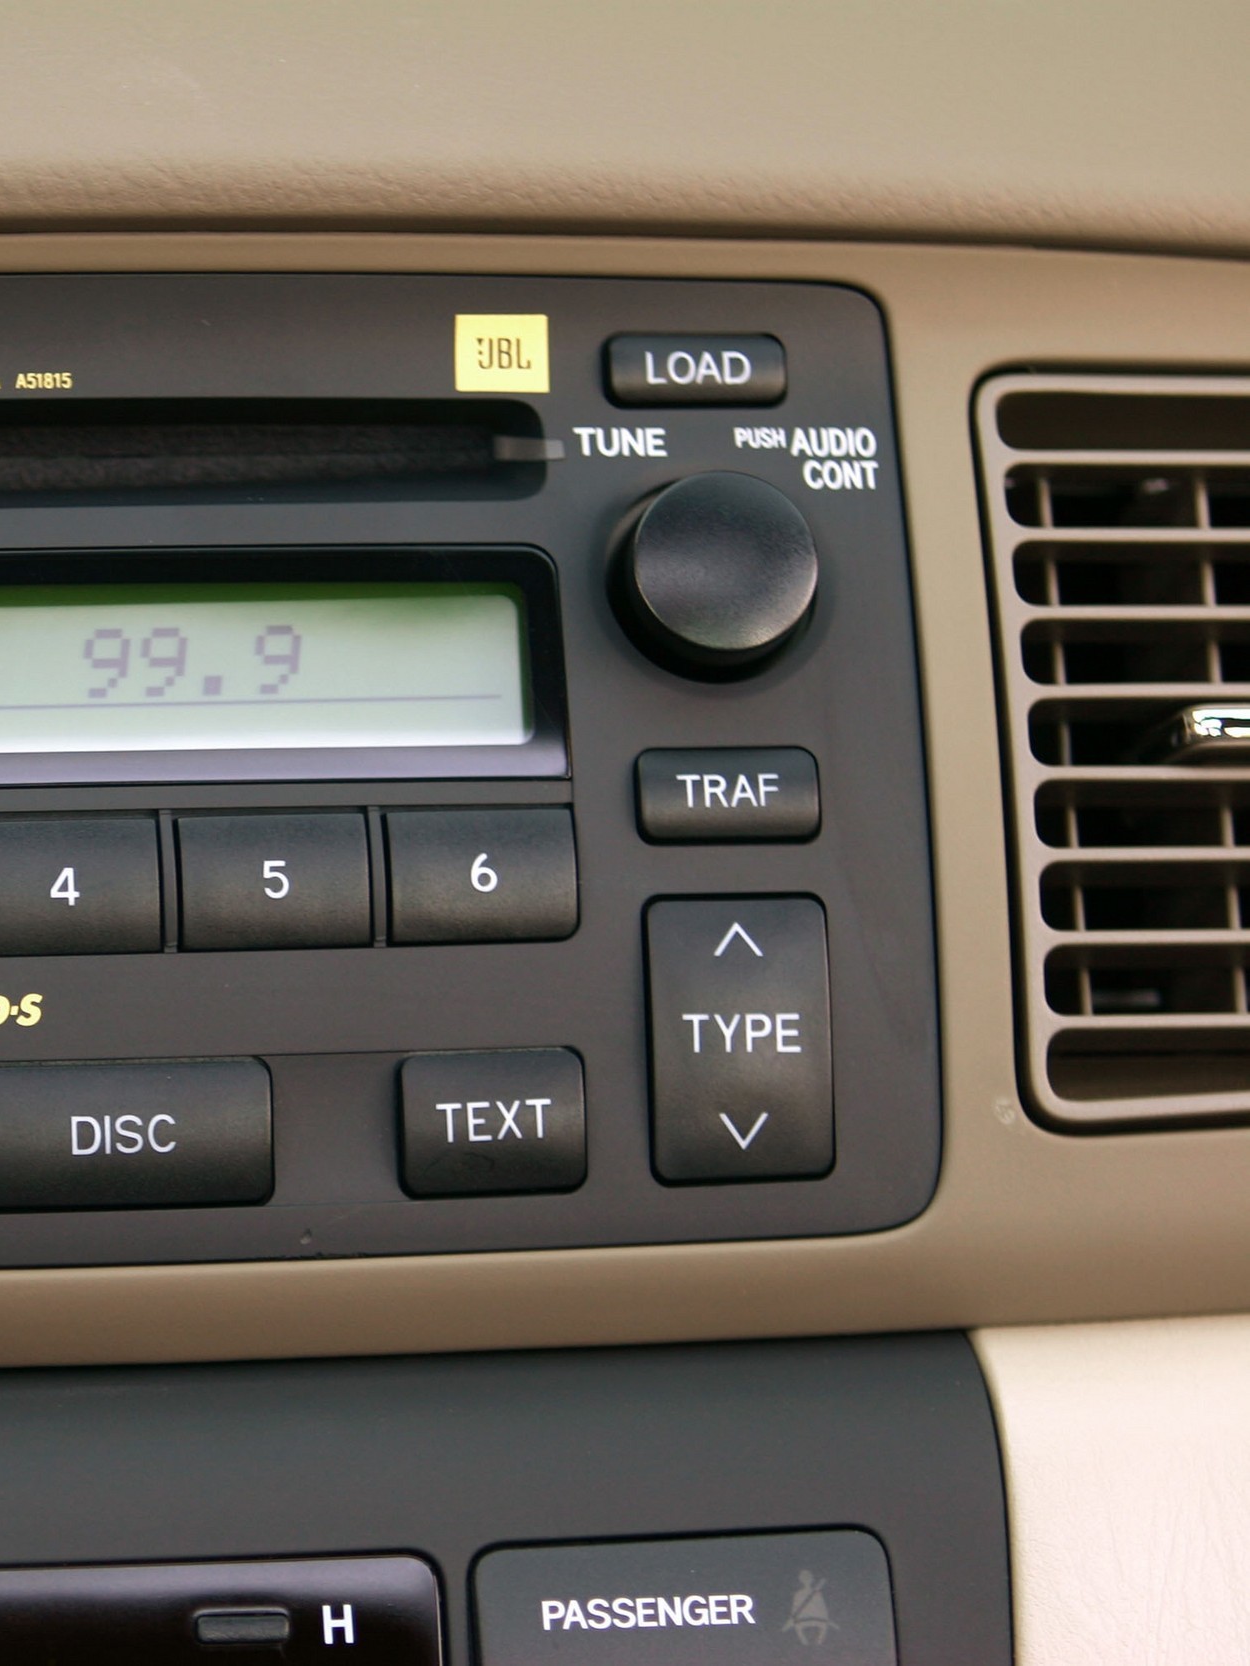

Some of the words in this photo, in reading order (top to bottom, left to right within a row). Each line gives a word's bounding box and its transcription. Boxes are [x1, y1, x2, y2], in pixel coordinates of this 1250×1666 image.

[476, 337, 532, 371] JBL
[645, 351, 753, 386] LOAD
[15, 372, 73, 390] A51815
[572, 426, 668, 458] TUNE
[733, 427, 788, 450] PUSH
[790, 427, 877, 458] AUDIO
[803, 459, 879, 490] CONT
[83, 624, 303, 698] 99.9
[676, 773, 780, 809] TRAF
[50, 867, 81, 906] 4
[263, 860, 290, 899] 5
[470, 853, 499, 893] 6
[682, 1013, 802, 1053] TYPE
[70, 1113, 177, 1156] DISC
[435, 1098, 552, 1143] TEXT
[322, 1603, 354, 1645] H
[541, 1594, 757, 1632] PASSENGER
